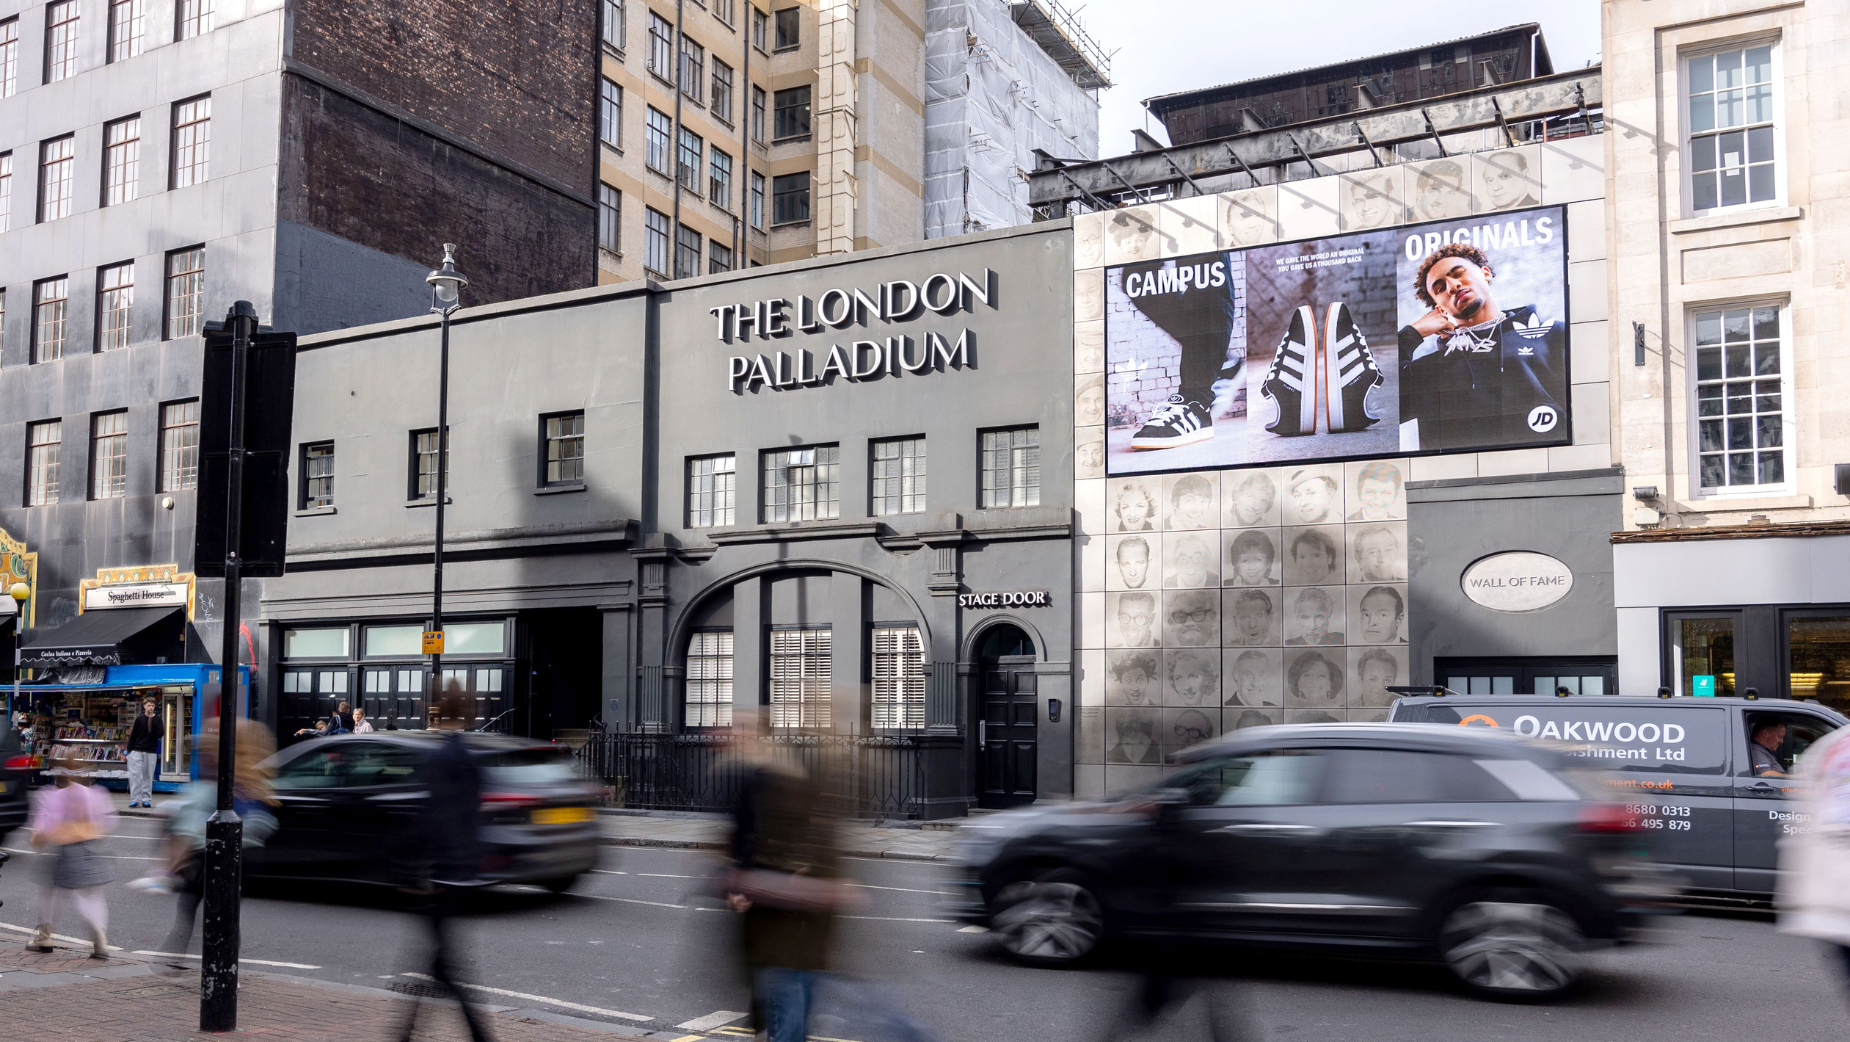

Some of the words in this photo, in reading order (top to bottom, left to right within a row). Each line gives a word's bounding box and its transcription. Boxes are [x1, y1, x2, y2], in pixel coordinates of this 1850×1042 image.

[1406, 216, 1553, 261] ORIGINALS
[1338, 248, 1364, 257] ORIGINAL
[1317, 258, 1346, 267] THOUSAND
[1126, 262, 1226, 298] CAMPUS
[710, 298, 787, 341] THE
[798, 268, 992, 331] LONDON
[728, 328, 969, 391] PALLADIUM
[1532, 412, 1554, 426] JD
[1470, 578, 1506, 588] WALL
[1509, 577, 1526, 586] OF
[1530, 576, 1565, 586] FAME
[108, 590, 140, 603] Spaghetti
[142, 591, 164, 599] House
[959, 593, 998, 606] STAGE
[1003, 591, 1045, 604] DOOR
[1656, 747, 1685, 761] Ltd
[1626, 804, 1656, 815] 8680
[1662, 806, 1691, 817] 0313
[1769, 810, 1811, 823] Design
[1641, 818, 1663, 829] 495
[1668, 820, 1691, 830] 879
